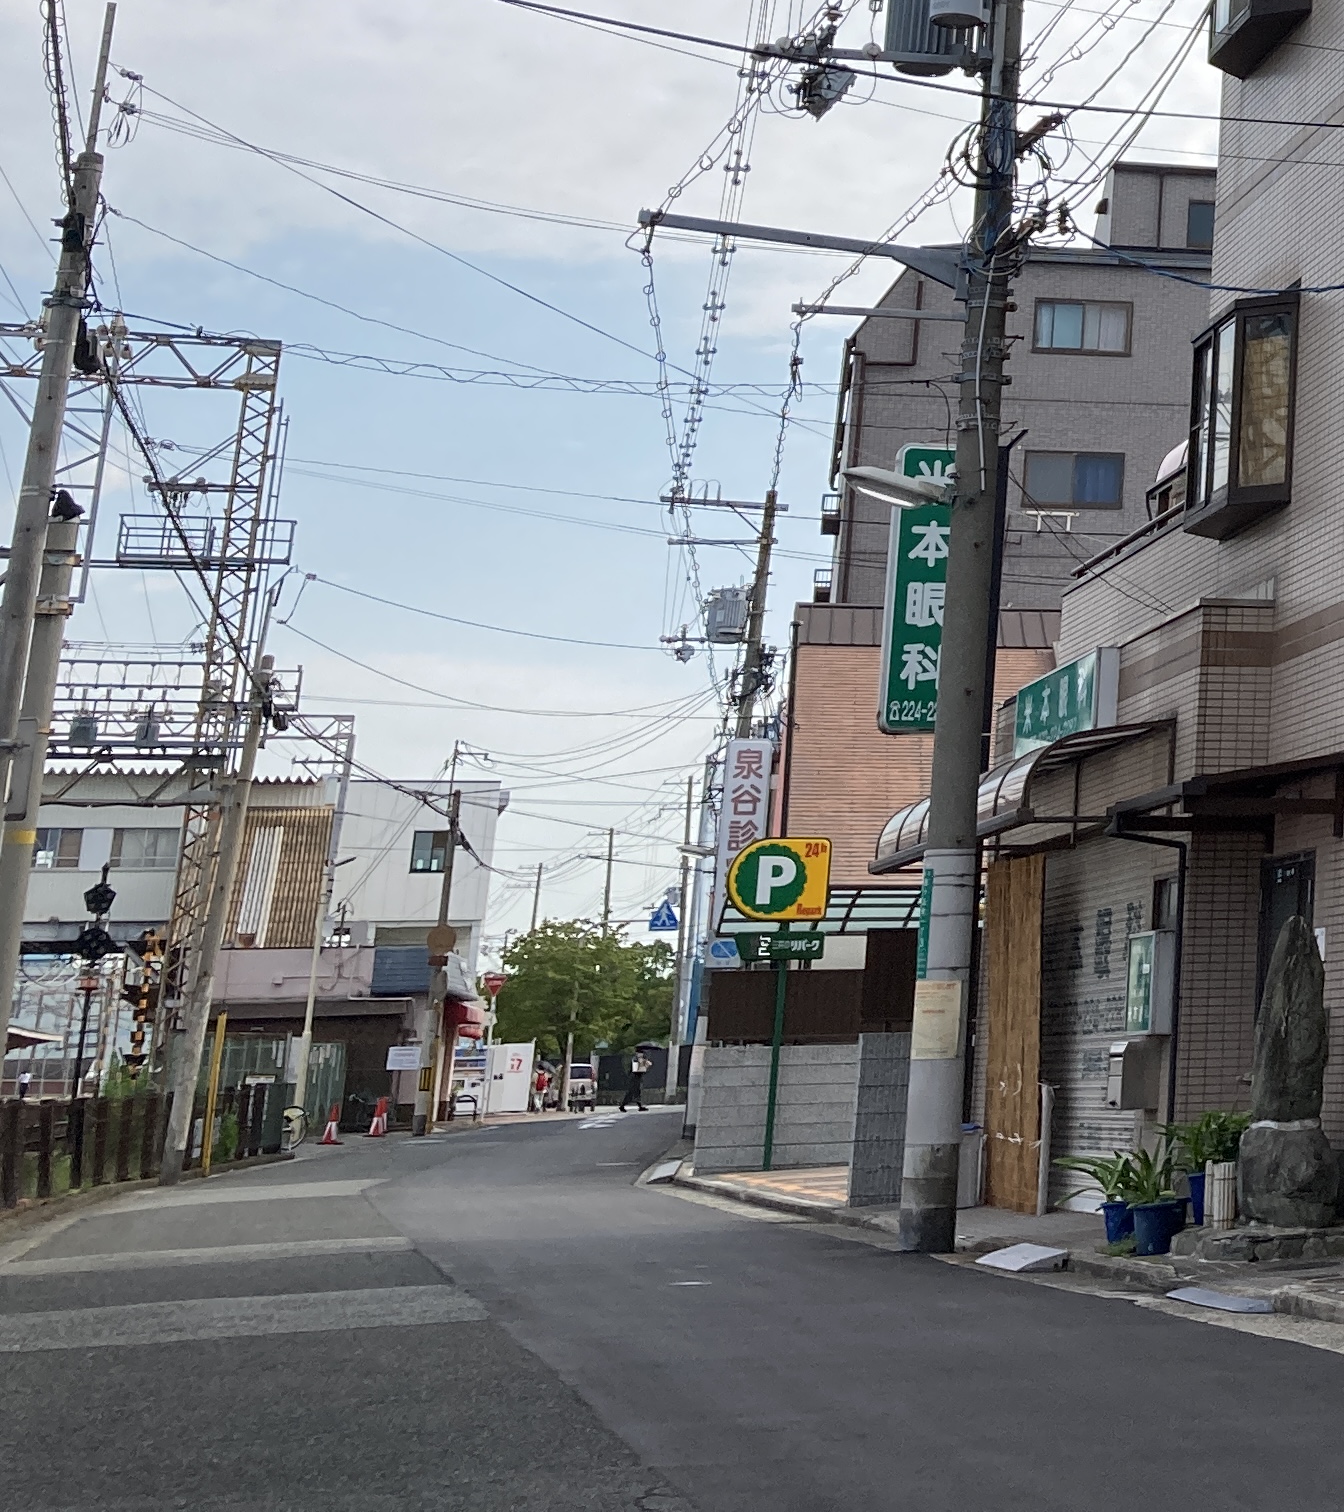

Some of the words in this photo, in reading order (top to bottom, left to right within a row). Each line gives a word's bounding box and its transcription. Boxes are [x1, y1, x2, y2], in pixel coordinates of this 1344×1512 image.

[727, 748, 764, 867] 泉谷診
[755, 855, 798, 905] P
